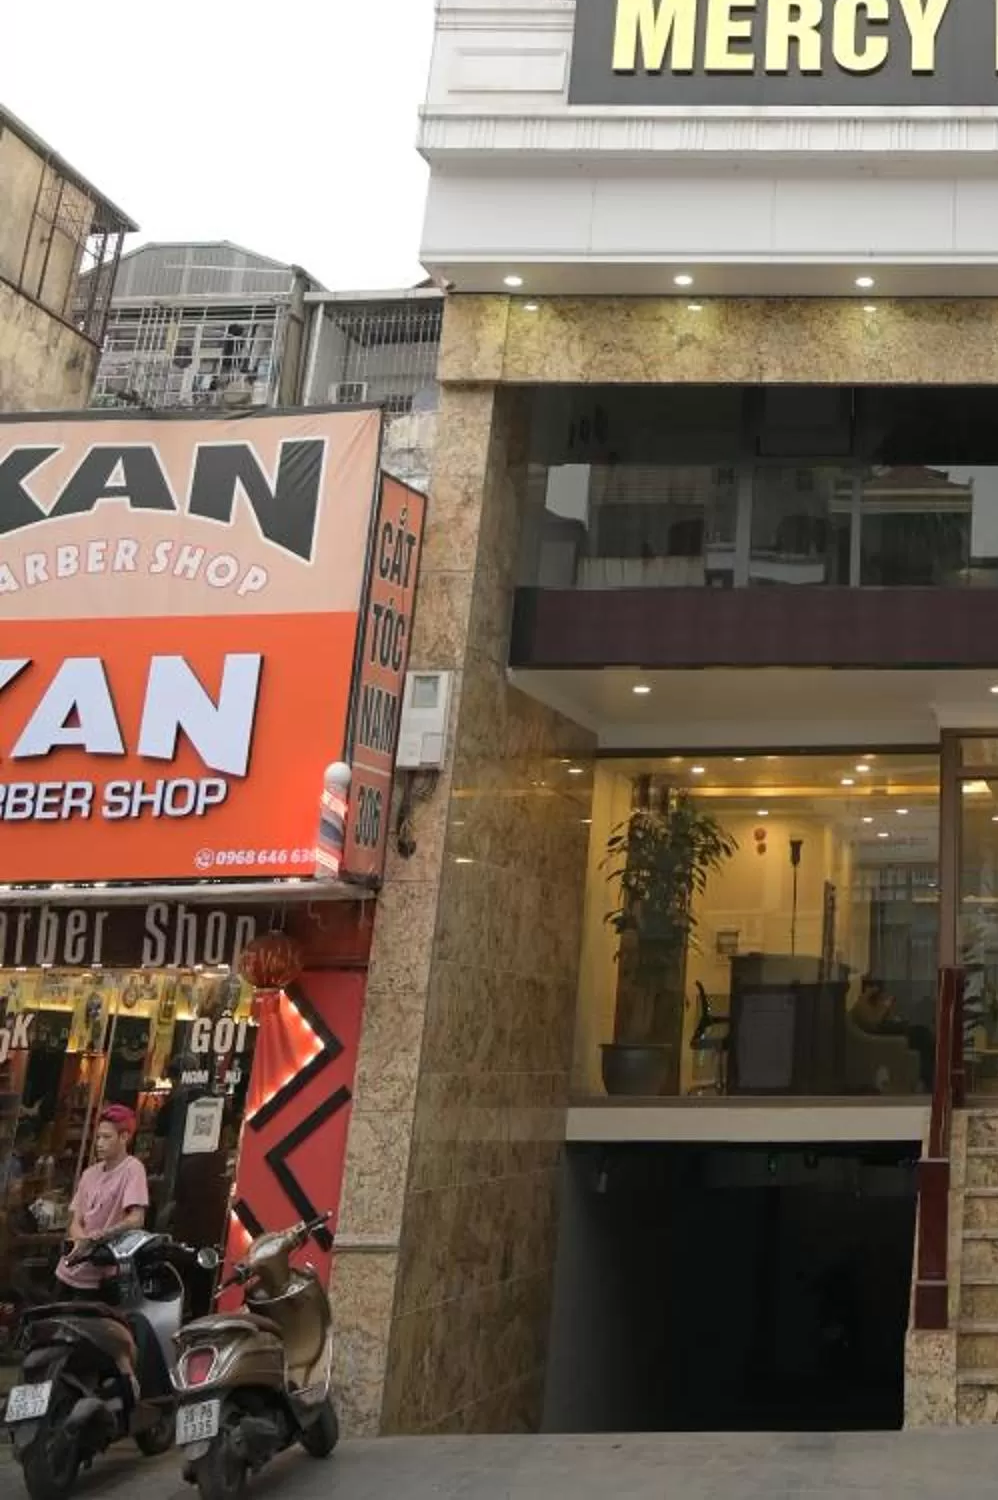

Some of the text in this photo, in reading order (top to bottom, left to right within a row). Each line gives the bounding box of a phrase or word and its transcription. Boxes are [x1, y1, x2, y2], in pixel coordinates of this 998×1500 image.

[149, 540, 268, 596] SHOP
[371, 597, 405, 672] TÓC
[0, 778, 227, 821] BER SHOP
[257, 848, 288, 865] 646
[142, 901, 256, 975] Shop
